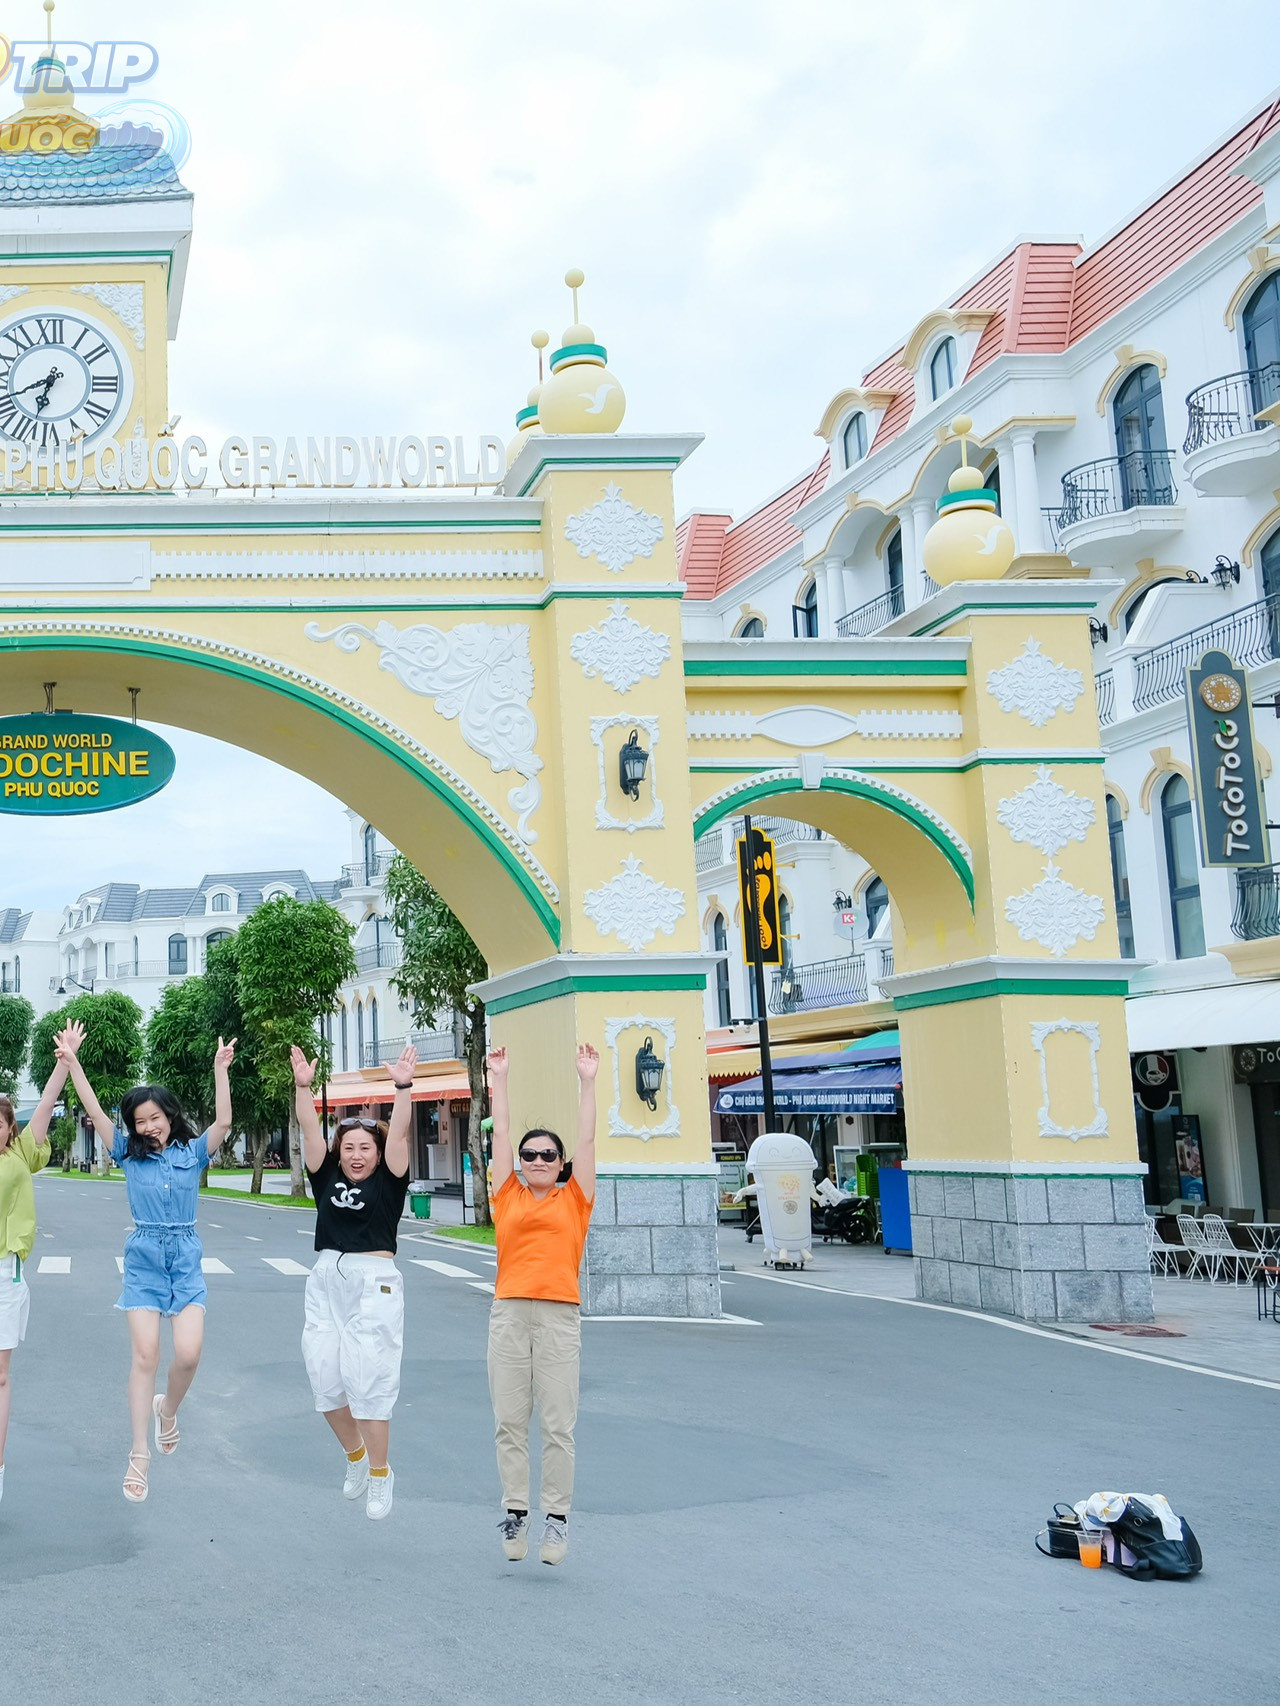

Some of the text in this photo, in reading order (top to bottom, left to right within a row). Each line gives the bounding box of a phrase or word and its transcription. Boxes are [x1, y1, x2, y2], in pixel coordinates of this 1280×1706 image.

[4, 429, 84, 491] PHÚ
[94, 415, 208, 491] QUỐC
[220, 435, 506, 488] GRANDWORLD
[52, 733, 112, 749] WORLD
[4, 781, 99, 798] PHU QUOC
[871, 1093, 894, 1104] MARKET
